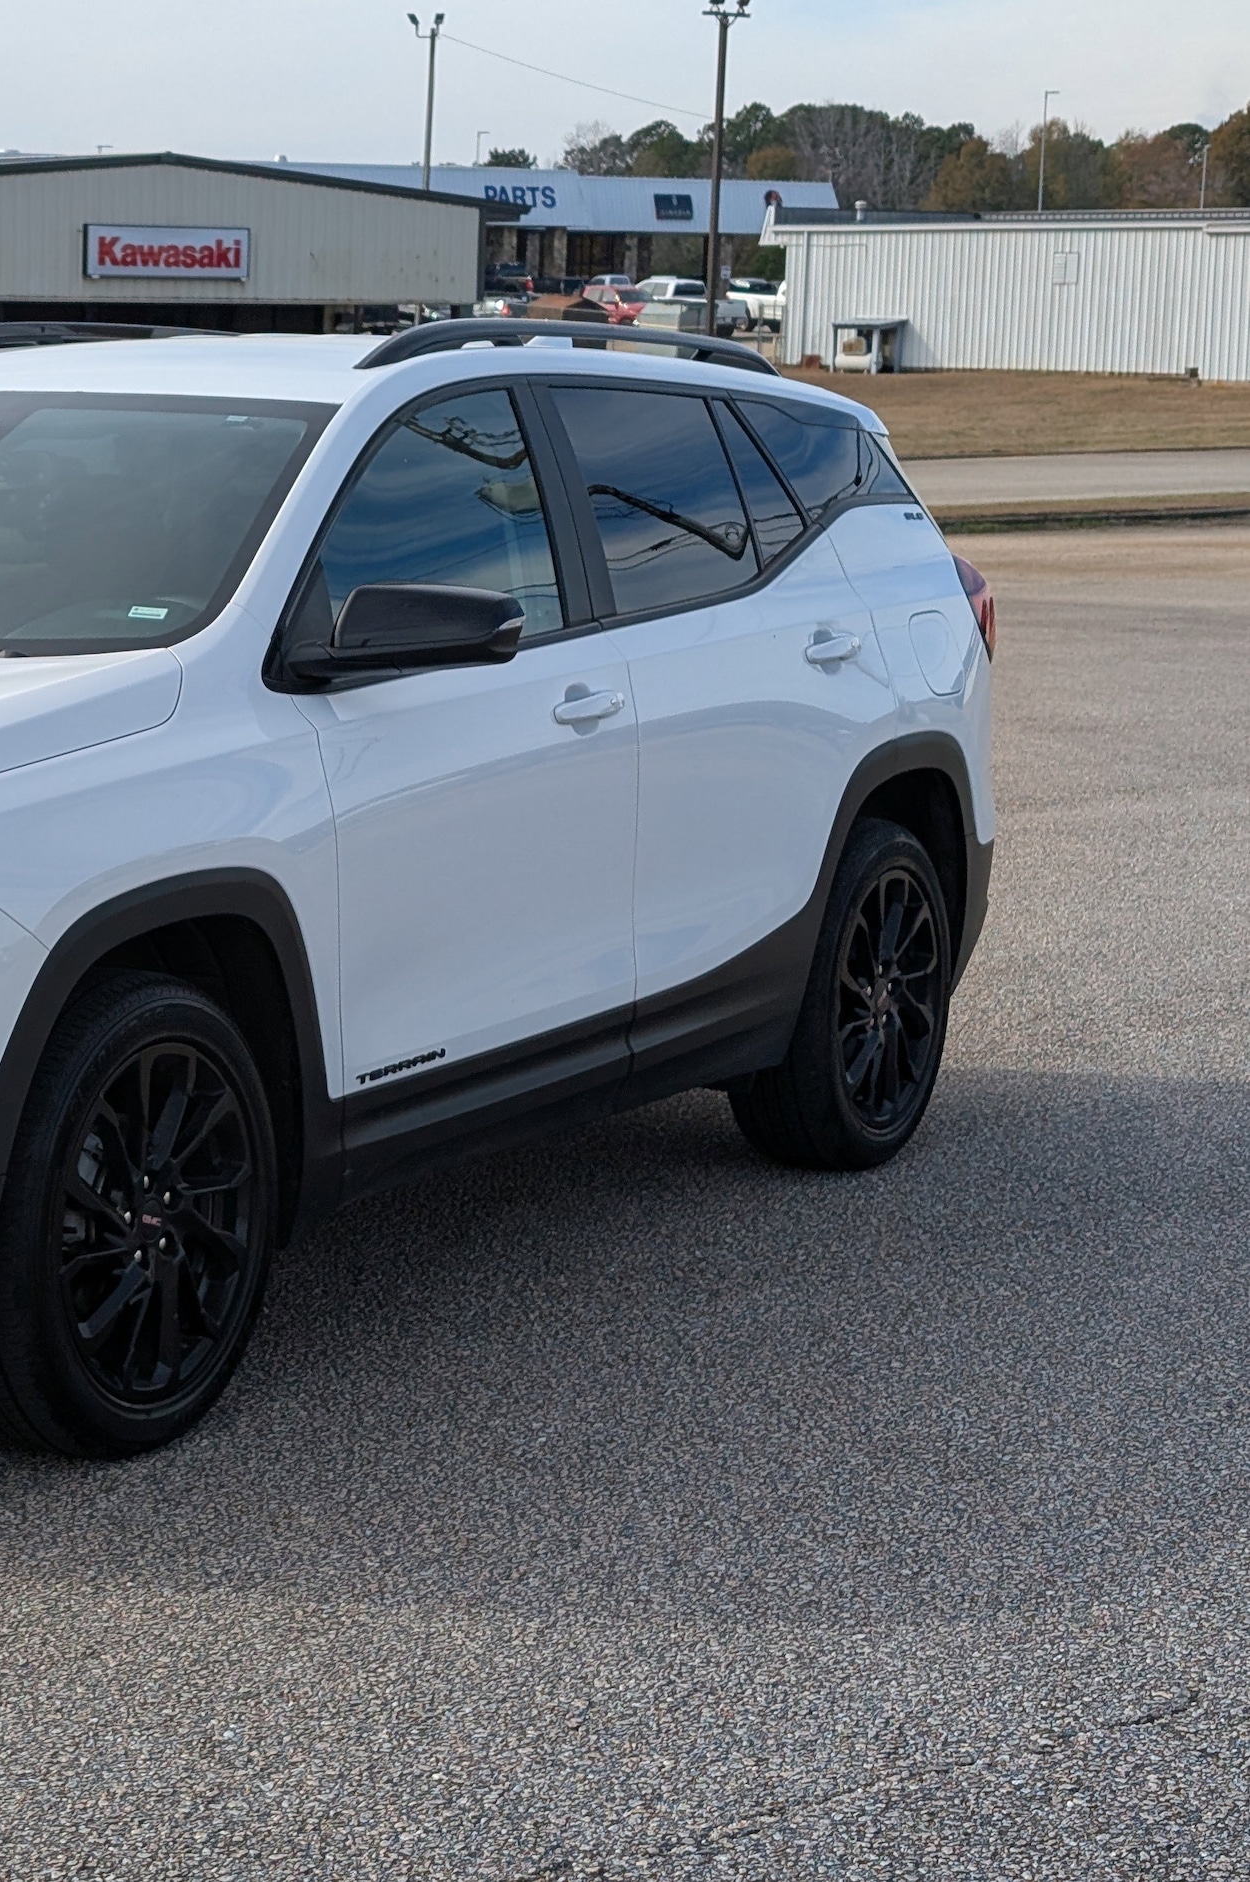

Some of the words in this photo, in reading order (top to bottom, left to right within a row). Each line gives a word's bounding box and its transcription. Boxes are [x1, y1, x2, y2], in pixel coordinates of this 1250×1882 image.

[484, 185, 557, 208] PARTS
[97, 236, 242, 268] Kawasaki
[355, 1047, 446, 1085] TERRAIN
